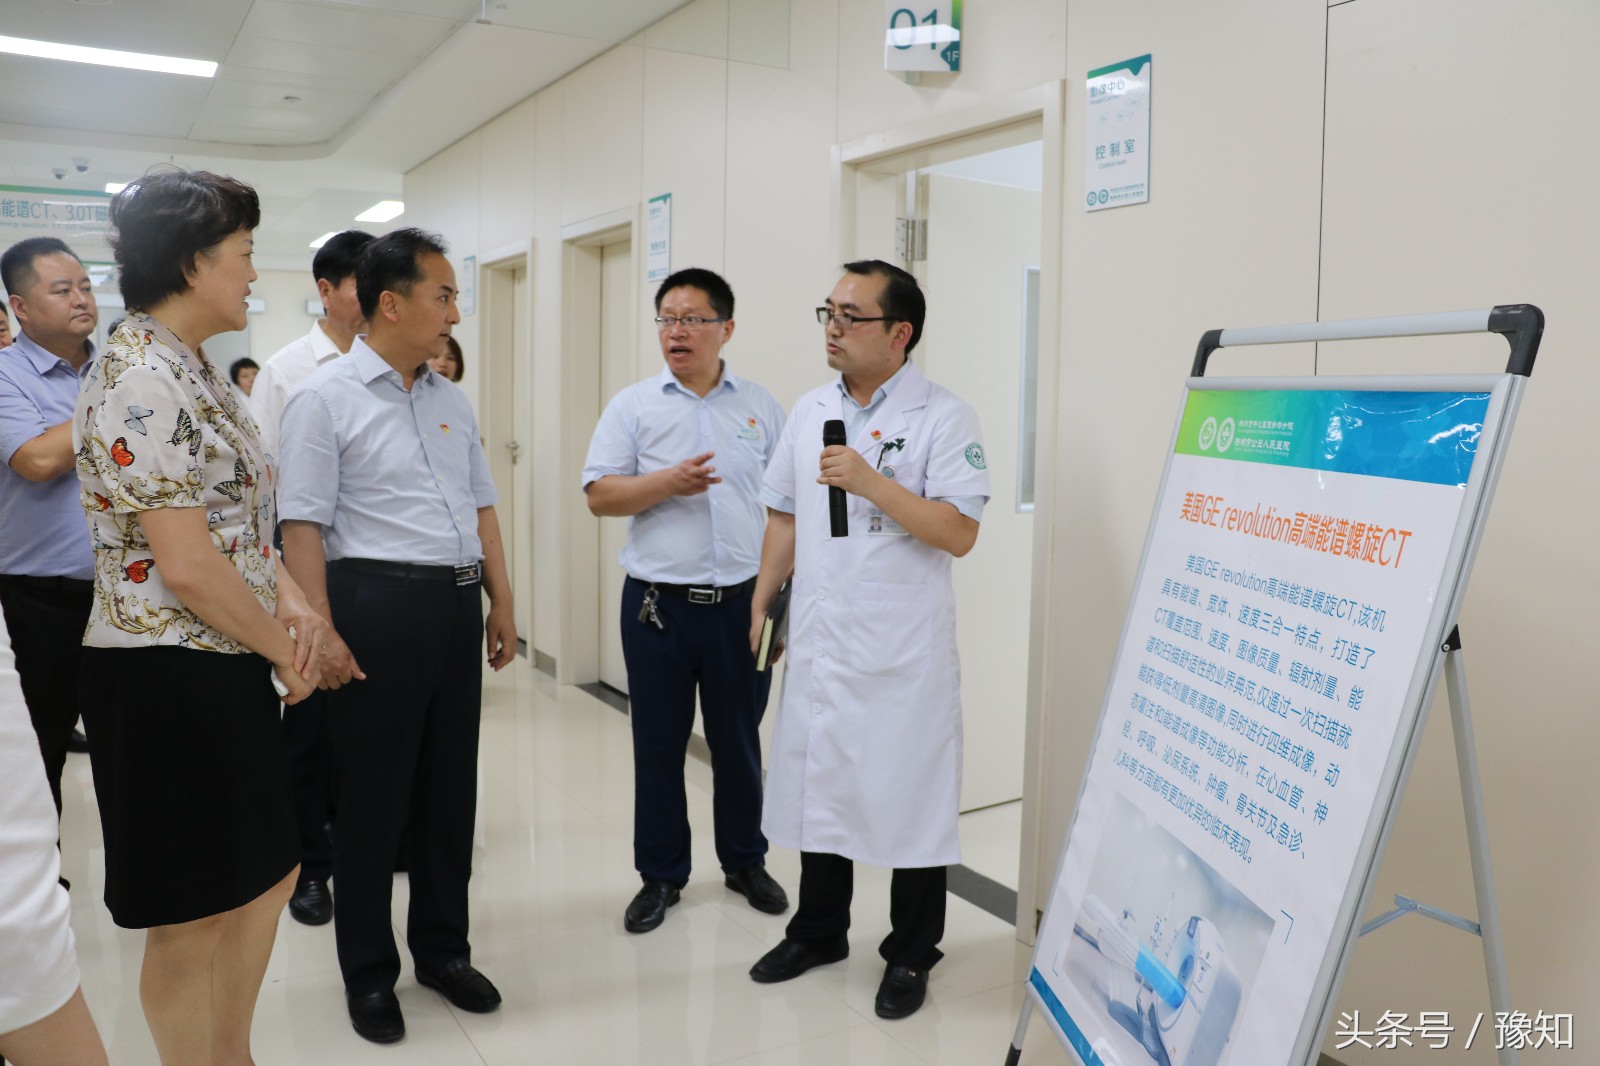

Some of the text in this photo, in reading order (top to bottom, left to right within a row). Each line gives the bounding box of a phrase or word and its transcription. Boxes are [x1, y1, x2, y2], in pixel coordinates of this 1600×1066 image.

[890, 8, 937, 50] 01
[946, 50, 960, 63] 1F
[1095, 139, 1135, 160] 控制室
[1180, 491, 1412, 569] 美国GE revolution高端能谱螺旋CT
